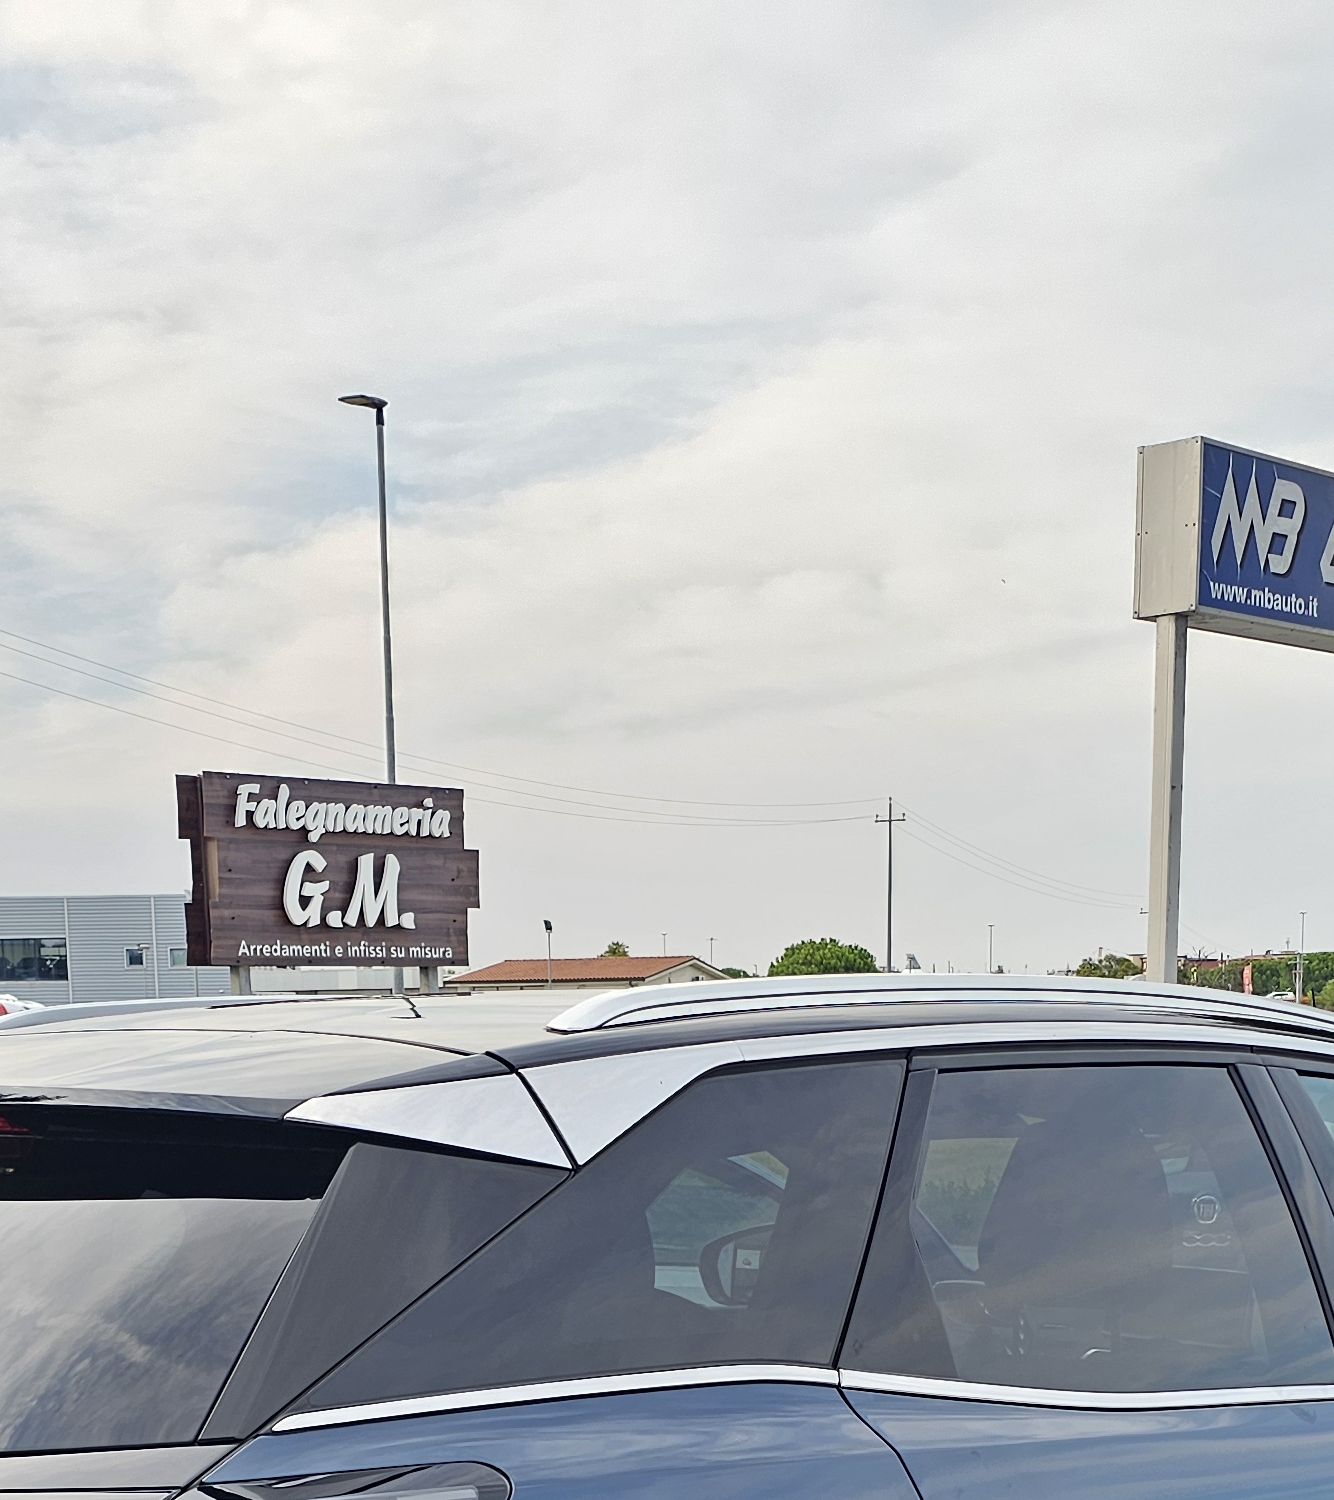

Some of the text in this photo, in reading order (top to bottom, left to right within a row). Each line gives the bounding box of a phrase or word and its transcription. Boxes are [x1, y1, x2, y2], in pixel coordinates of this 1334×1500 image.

[1210, 453, 1306, 577] MB
[1209, 580, 1319, 618] www.mbauto.it
[234, 783, 451, 843] Falegnameria
[283, 849, 416, 929] G.M.
[238, 940, 453, 959] Arredamenti e infissi su misura
